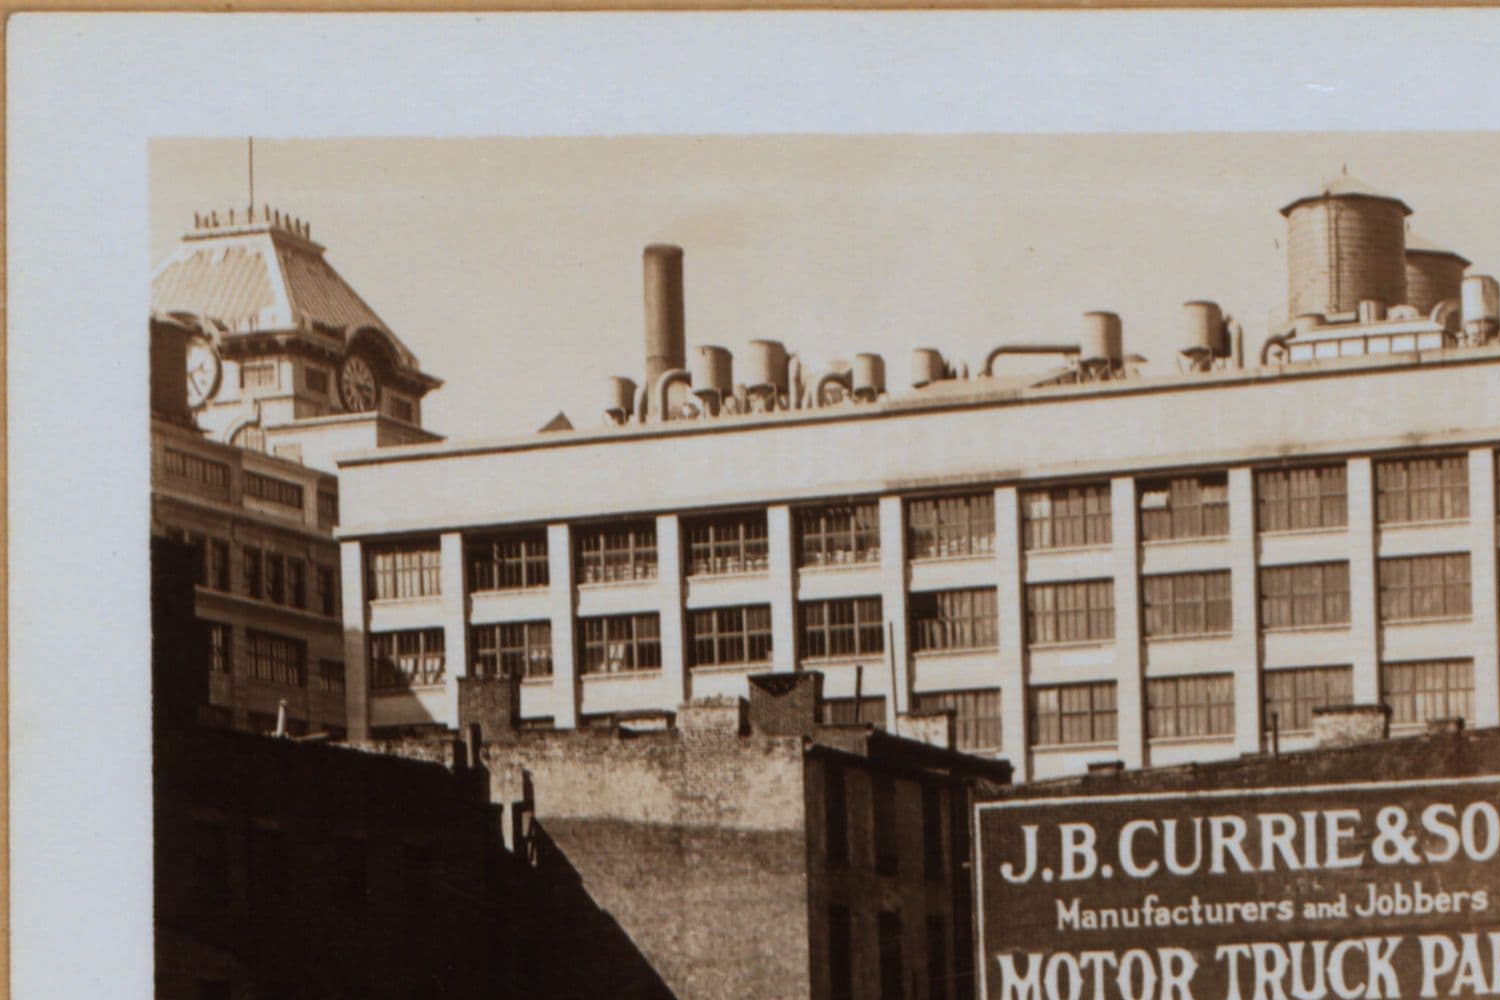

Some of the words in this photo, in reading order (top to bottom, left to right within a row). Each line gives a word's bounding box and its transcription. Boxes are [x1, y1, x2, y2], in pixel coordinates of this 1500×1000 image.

[1118, 808, 1364, 878] CURRIE
[1055, 895, 1294, 932] Manufacturers
[1303, 895, 1348, 921] and
[1354, 883, 1489, 917] Jobbers
